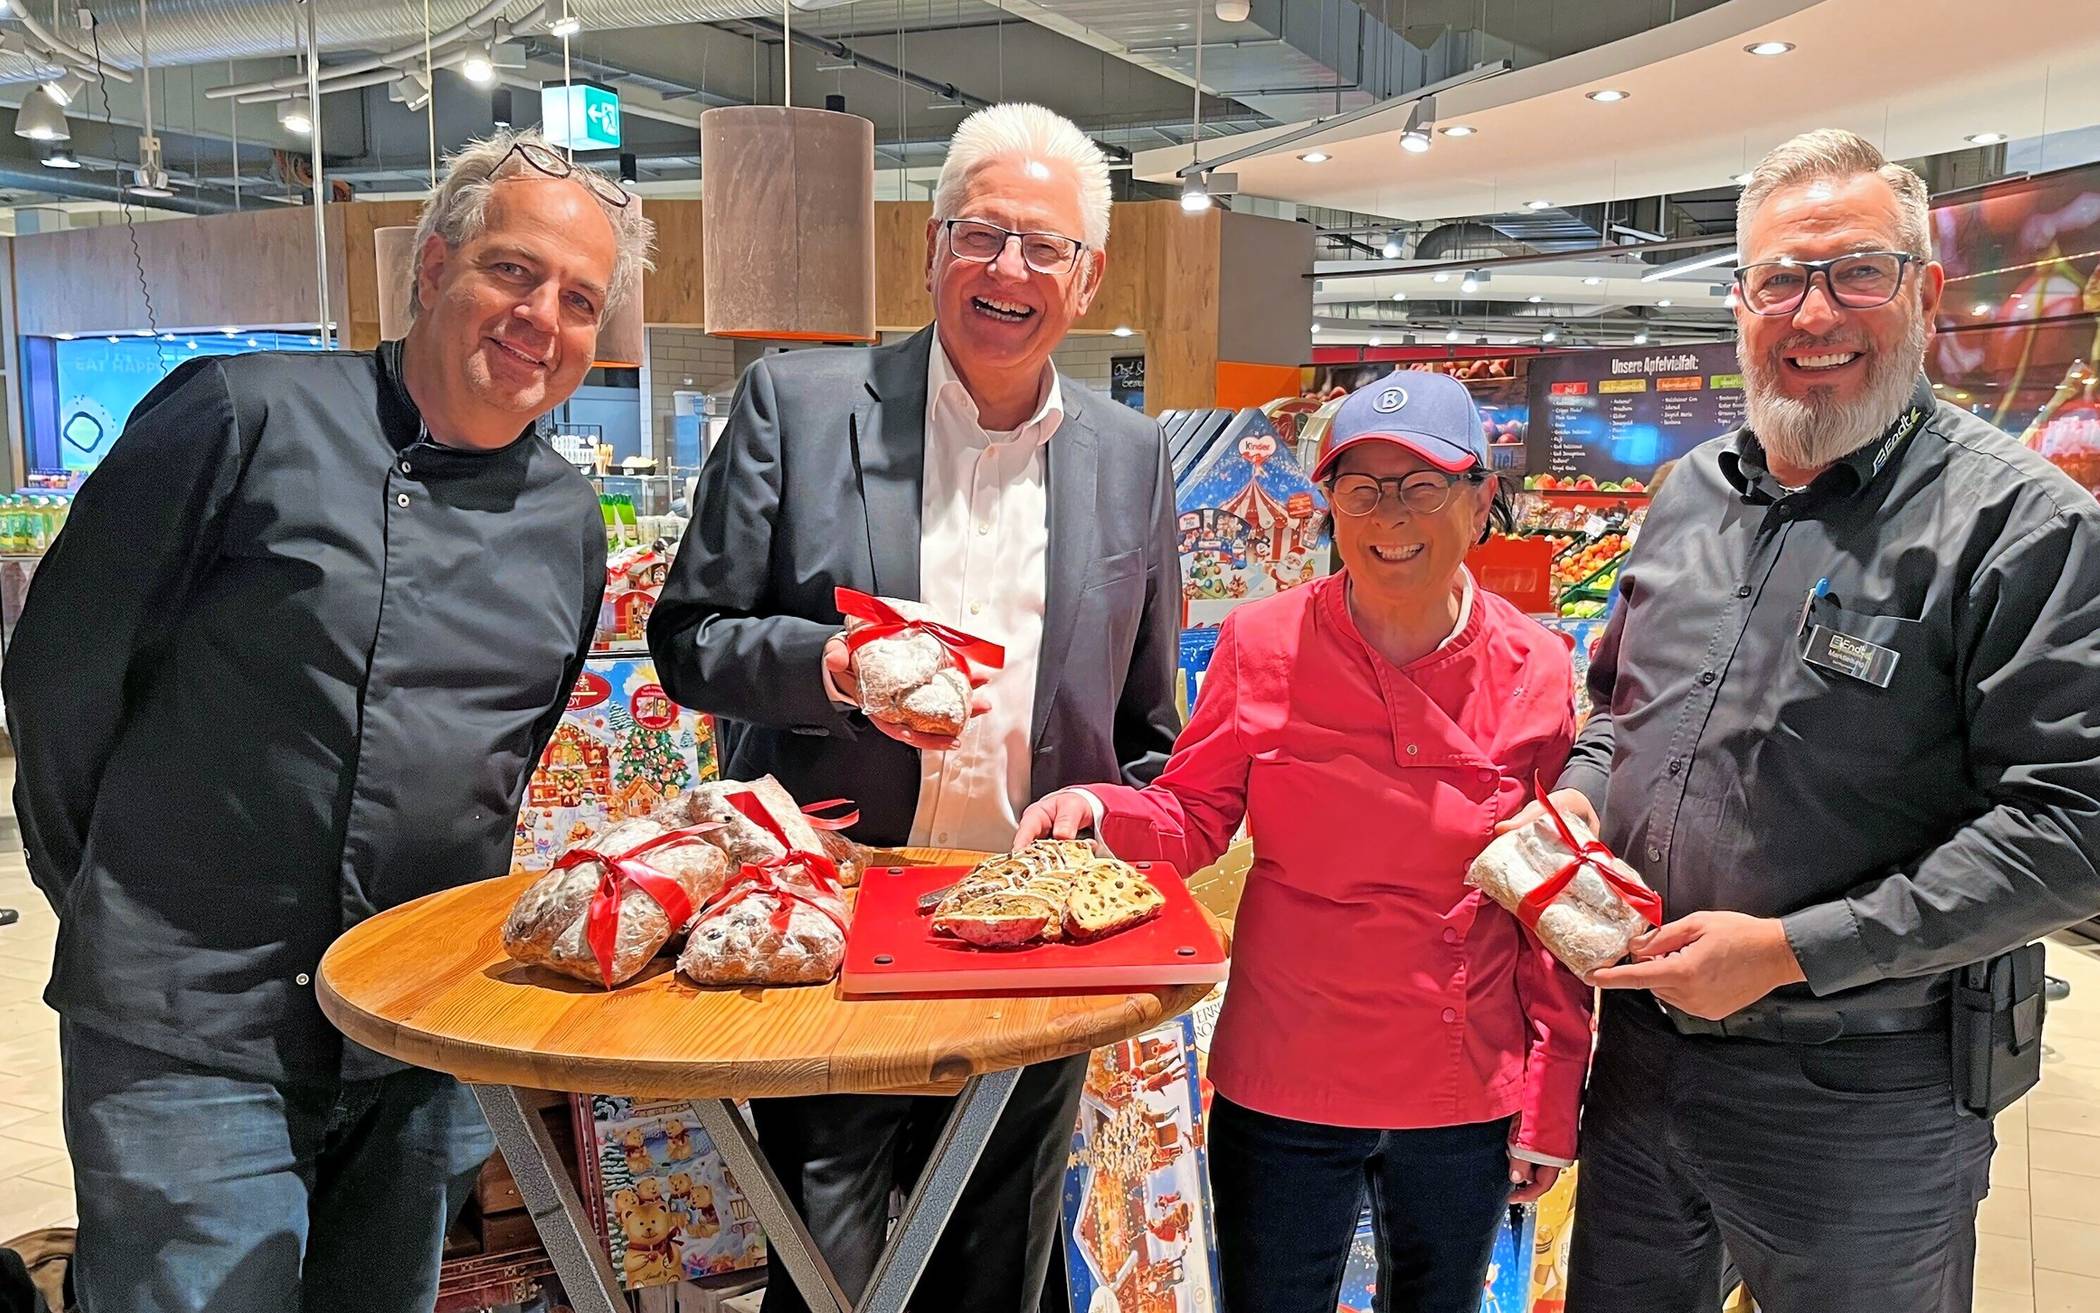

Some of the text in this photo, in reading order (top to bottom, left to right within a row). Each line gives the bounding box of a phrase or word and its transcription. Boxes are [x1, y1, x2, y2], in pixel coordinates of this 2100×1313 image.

[1135, 361, 1144, 376] &
[1612, 354, 1699, 376] Unsere Apfelvielfalt:
[1196, 1001, 1221, 1023] ERR
